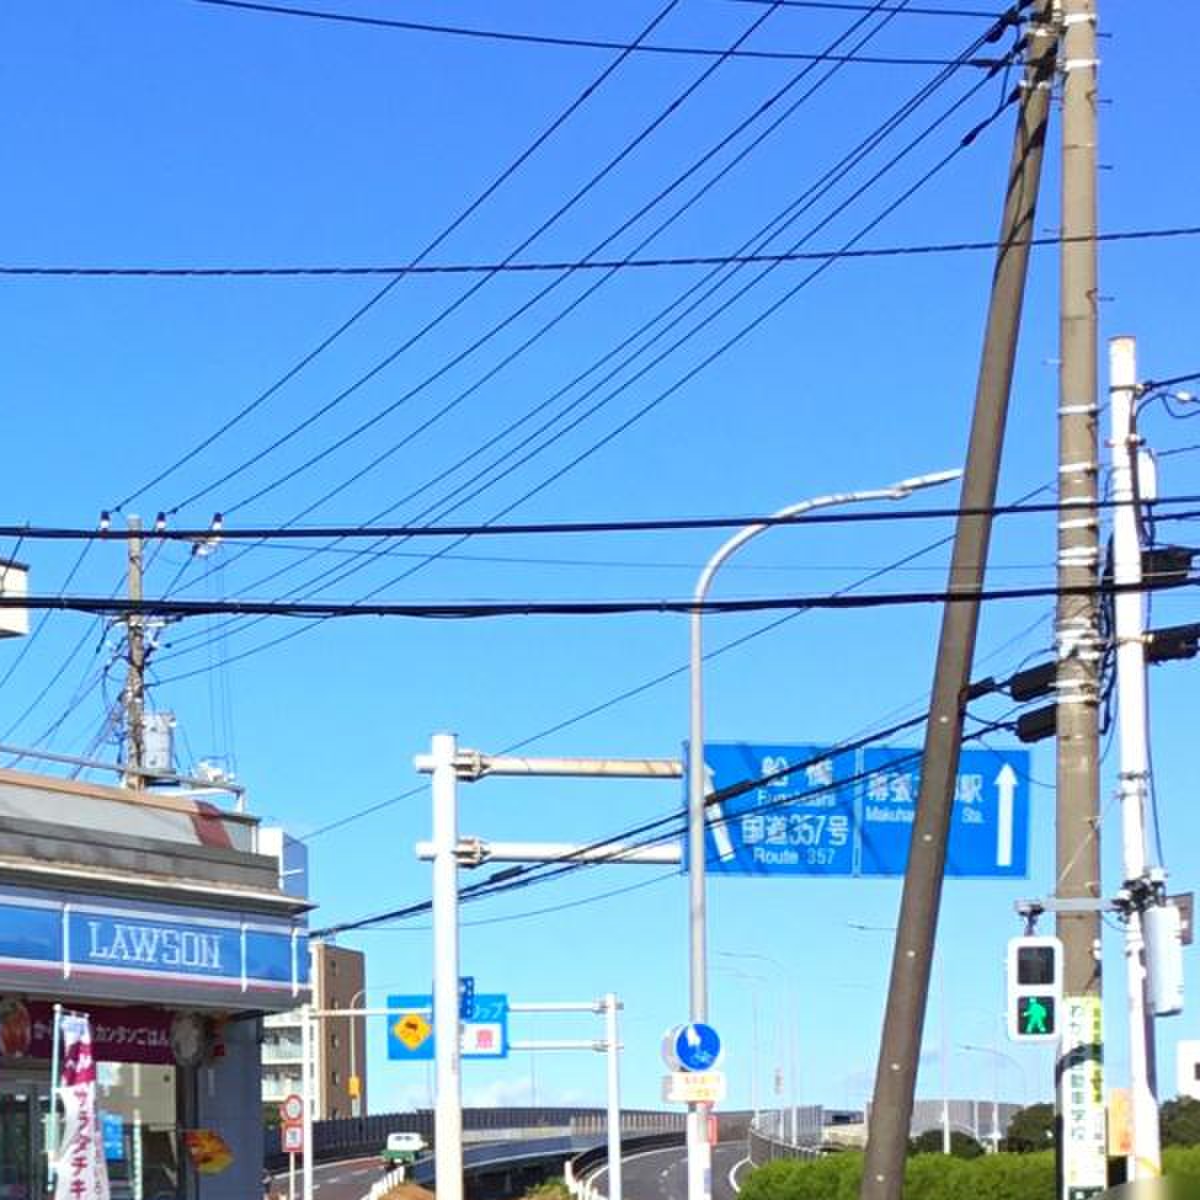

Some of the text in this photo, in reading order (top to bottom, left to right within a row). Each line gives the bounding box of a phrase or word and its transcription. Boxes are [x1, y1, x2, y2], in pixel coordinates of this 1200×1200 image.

[741, 815, 849, 846] 国道357号
[753, 848, 836, 864] Route 357
[87, 920, 223, 969] LAWSON
